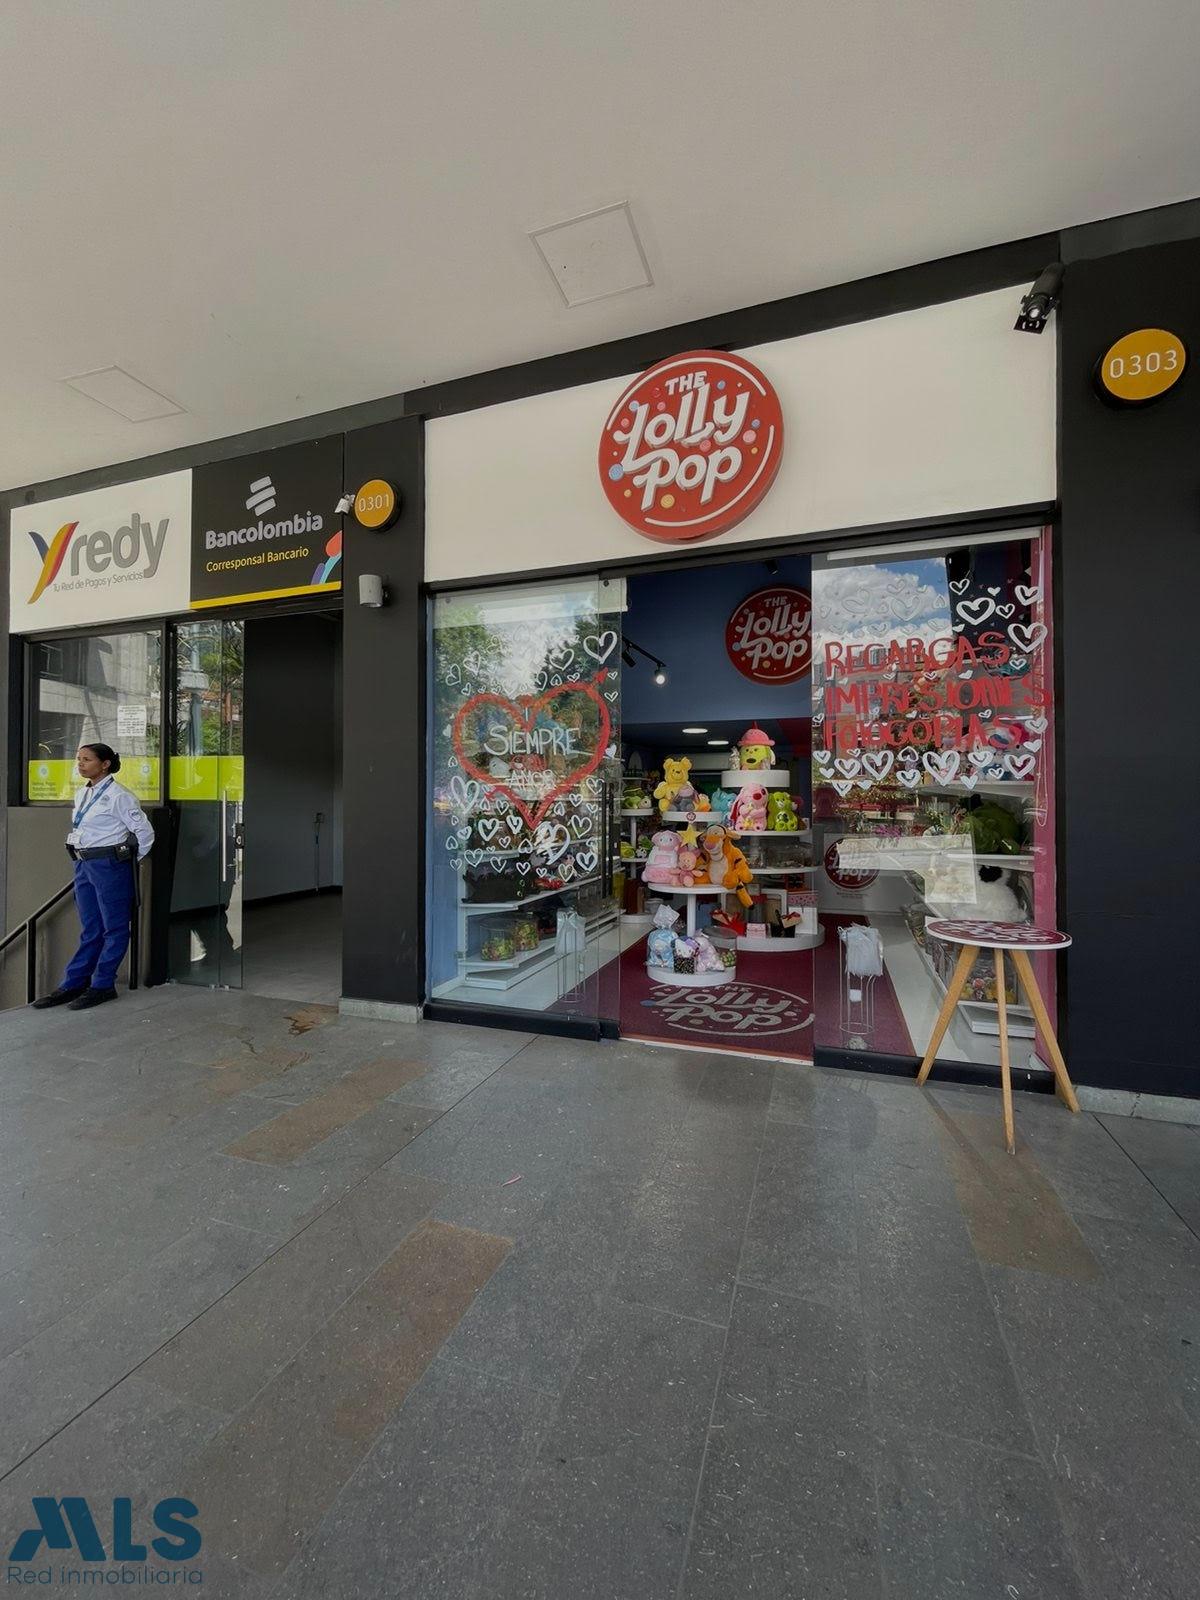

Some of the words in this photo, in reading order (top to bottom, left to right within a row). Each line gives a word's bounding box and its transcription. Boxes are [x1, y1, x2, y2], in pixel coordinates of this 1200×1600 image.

[1109, 349, 1178, 379] 0303
[664, 370, 708, 396] THE
[358, 493, 390, 513] 0301
[204, 510, 324, 550] Bancolombia
[205, 551, 266, 573] Corresponsal
[267, 545, 310, 563] Bancario
[61, 581, 75, 591] Red
[85, 578, 107, 589] Pagos
[112, 571, 144, 584] Servicios
[763, 595, 788, 608] THE
[824, 631, 1011, 678] RECARGAS
[484, 725, 585, 756] SIEMPRE
